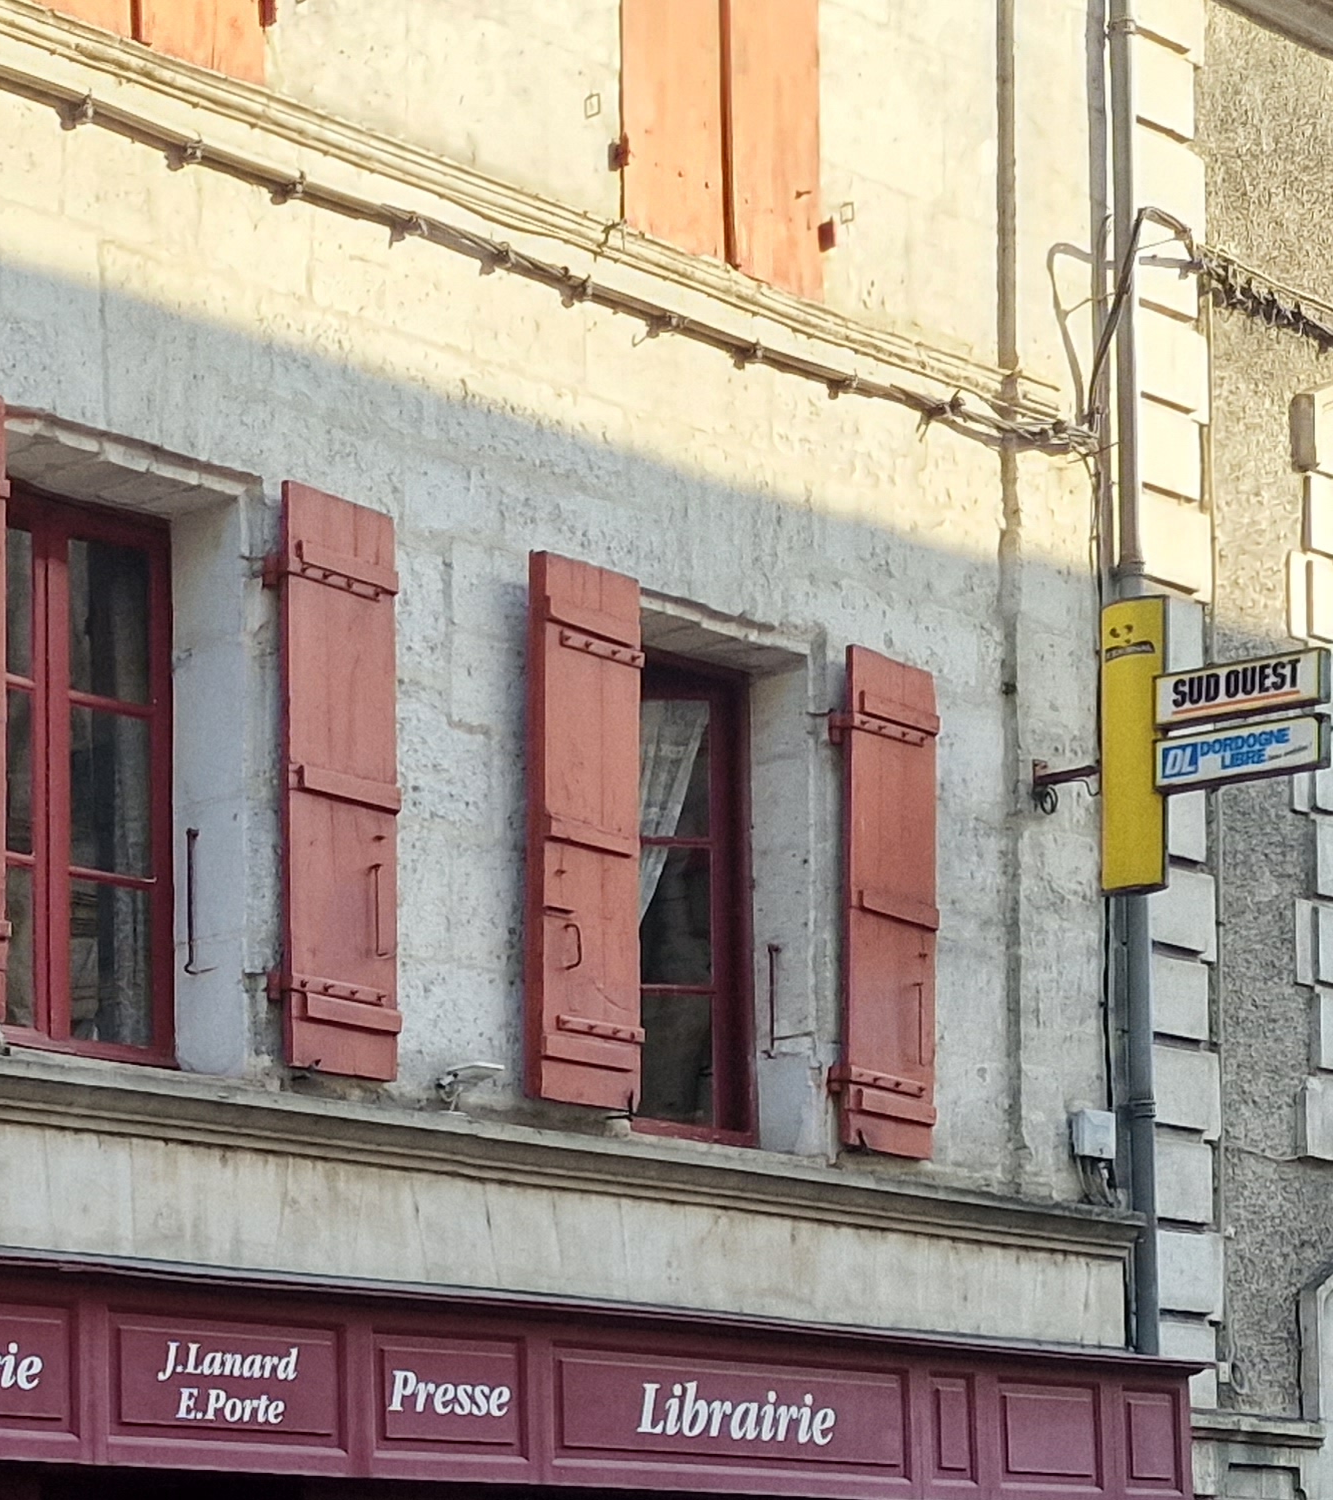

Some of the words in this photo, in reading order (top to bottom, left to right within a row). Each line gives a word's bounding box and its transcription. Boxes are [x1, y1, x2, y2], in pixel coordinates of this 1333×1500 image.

[1171, 673, 1221, 708] SUD
[1225, 657, 1301, 699] OUEST
[1164, 745, 1198, 777] DL
[1199, 726, 1291, 757] DORDOGNE
[1220, 748, 1268, 770] LIBRE
[156, 1340, 300, 1382] J.Lanard
[175, 1386, 286, 1424] E.Porte
[386, 1368, 511, 1417] Presse
[636, 1380, 837, 1446] Librairie
